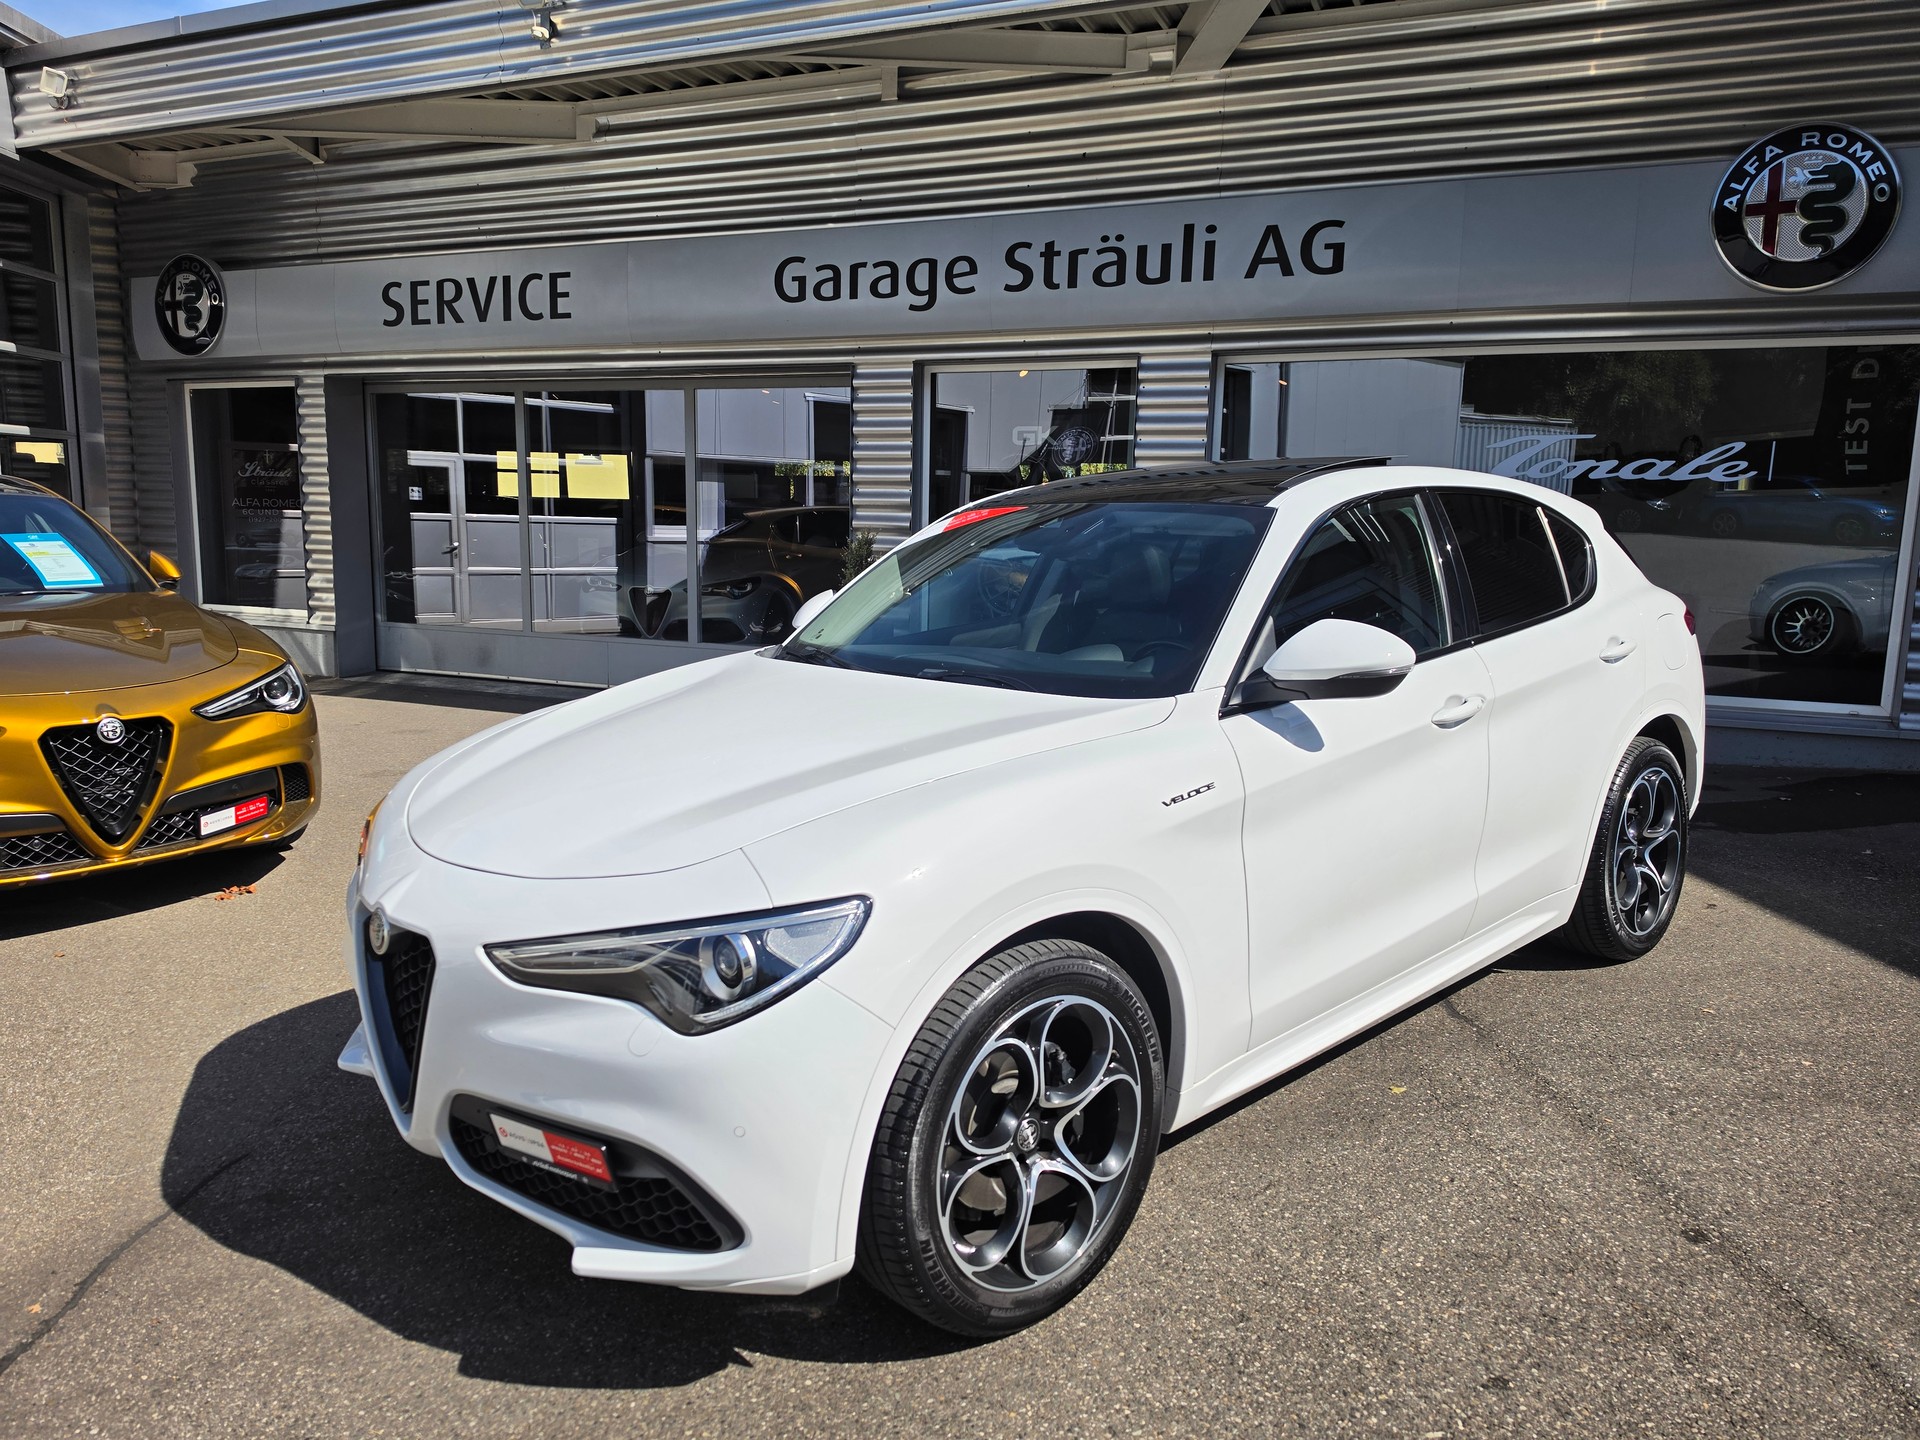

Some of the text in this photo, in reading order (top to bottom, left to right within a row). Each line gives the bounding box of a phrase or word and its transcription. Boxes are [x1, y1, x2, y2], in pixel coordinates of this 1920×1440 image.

[1723, 131, 1891, 212] ALFA ROMEO
[157, 260, 219, 306] ALFA ROMEO
[773, 219, 1346, 312] Garage Sträuli AG
[381, 271, 572, 328] SERVICE
[1485, 433, 1758, 482] Tonale
[1844, 398, 1872, 475] TEST
[231, 498, 261, 507] ALFA
[1161, 781, 1217, 807] VELOCE
[1122, 988, 1161, 1063] MICHELIN
